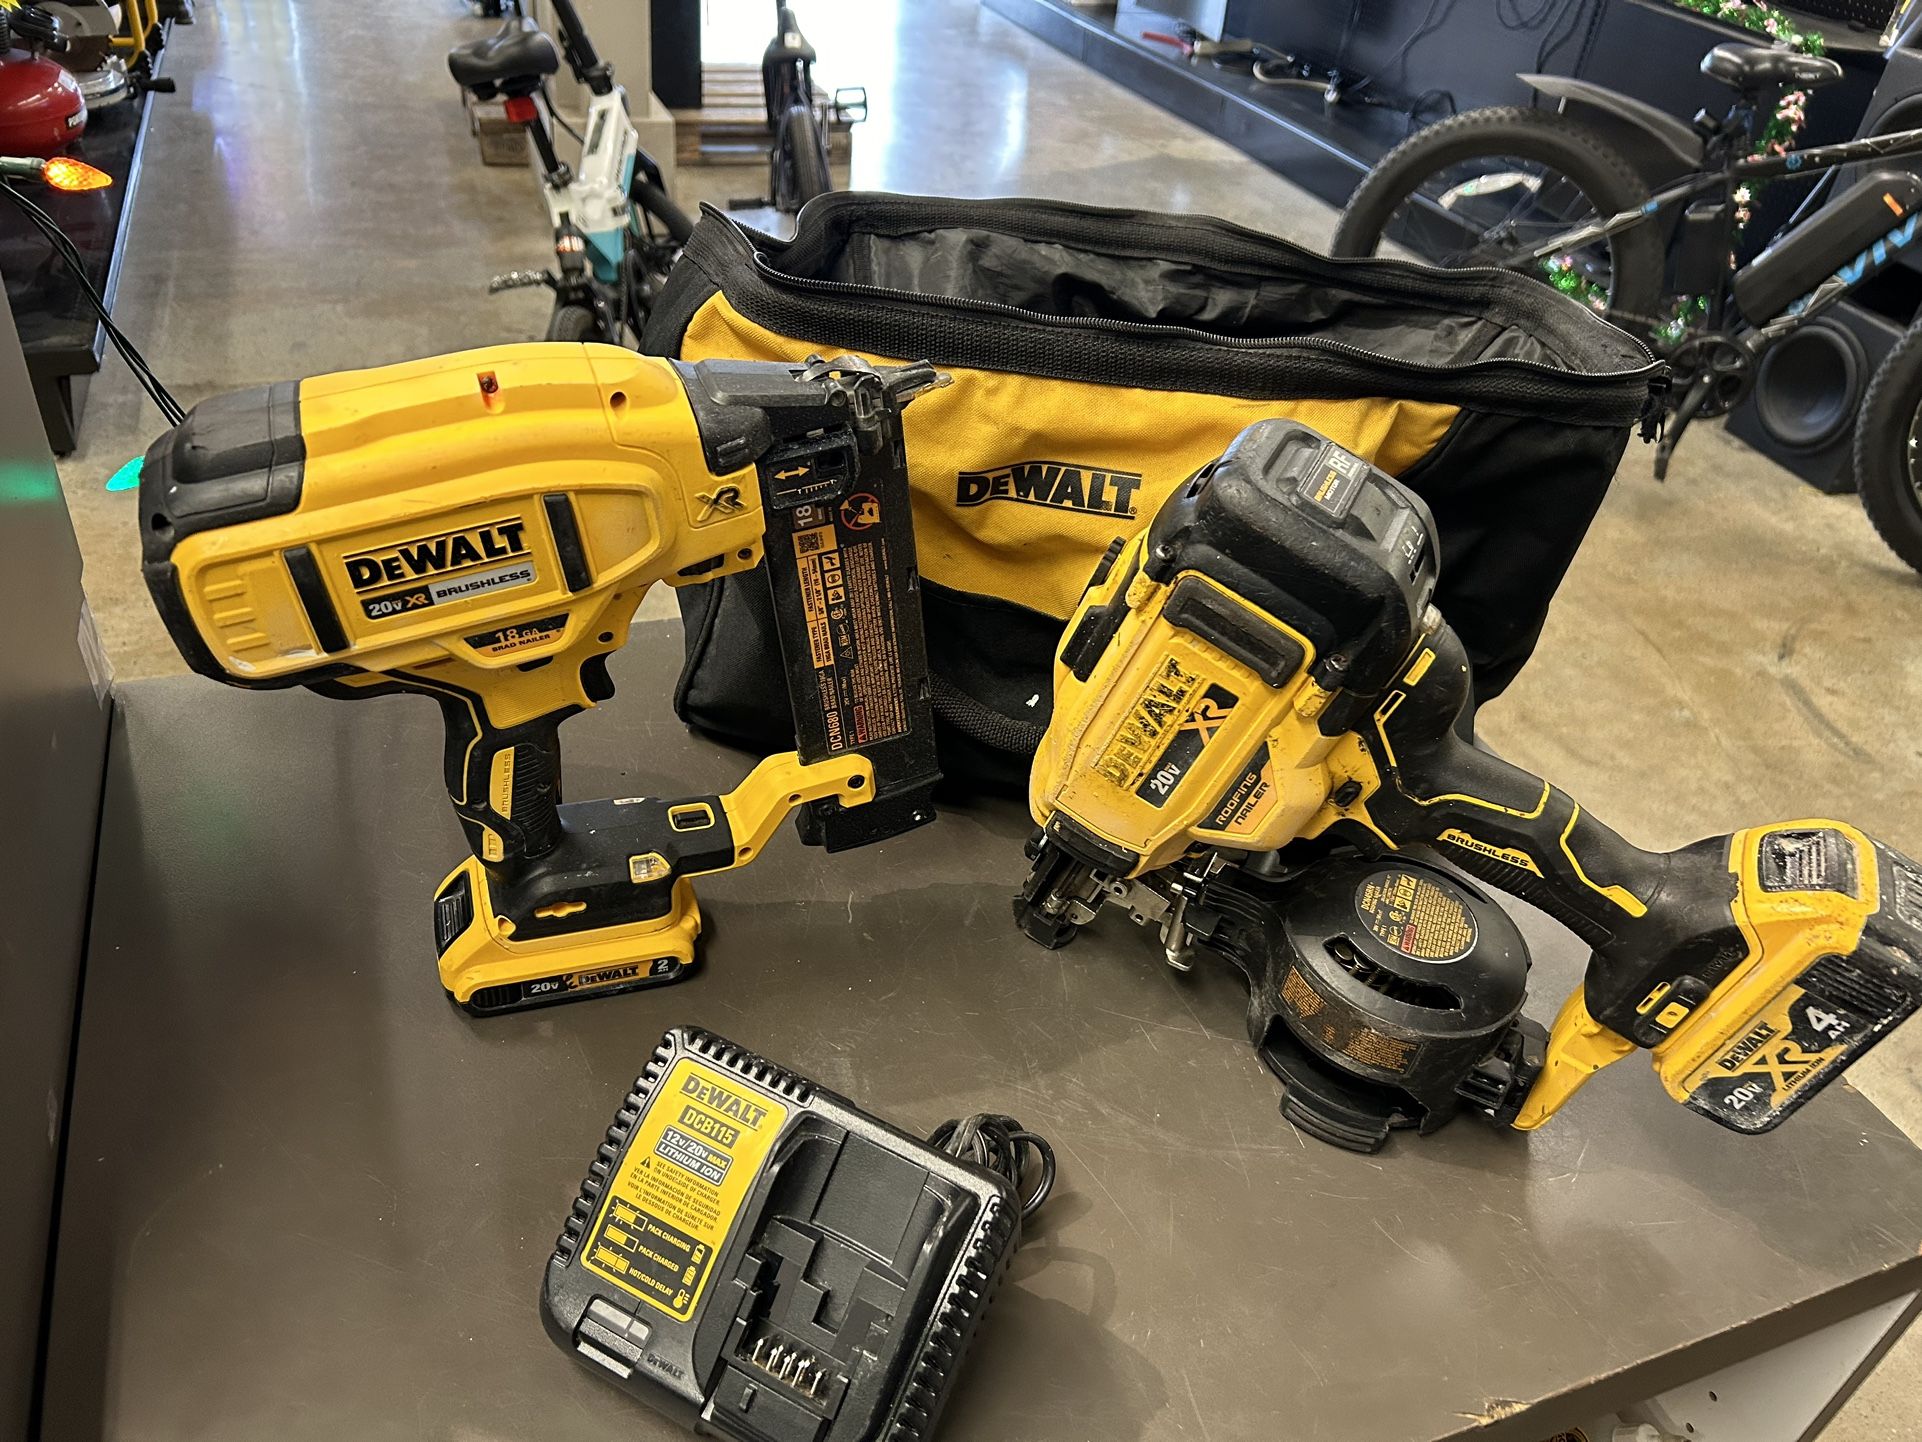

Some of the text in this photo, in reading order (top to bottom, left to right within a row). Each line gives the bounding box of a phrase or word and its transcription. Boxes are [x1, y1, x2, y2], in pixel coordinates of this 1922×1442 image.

[695, 485, 747, 522] XR
[957, 464, 1142, 514] DEWALT
[1323, 478, 1340, 500] MOTOR
[795, 504, 813, 526] 18
[344, 521, 528, 588] DEWALT
[405, 591, 429, 607] XR
[435, 569, 531, 598] BRUSHLESS
[492, 633, 551, 652] BRAD NAILER
[495, 628, 540, 643] 18 GA
[820, 683, 830, 710] BRUSHLESS
[825, 710, 843, 750] DCN680
[853, 705, 866, 734] WARNING
[1095, 656, 1198, 789] DEWALT
[1176, 694, 1233, 746] XR
[501, 753, 510, 811] BRUSHLESS
[1215, 771, 1257, 825] ROOFING
[1233, 781, 1270, 826] NAILER
[1446, 832, 1529, 867] BRUSHLESS
[578, 964, 639, 985] DEWALT
[656, 959, 669, 969] 2
[1805, 1006, 1838, 1032] 4
[1827, 1021, 1851, 1040] AH
[1717, 1021, 1779, 1071] DEWALT
[1781, 1056, 1824, 1091] LITHIUM ION
[680, 1074, 767, 1127] DEWALT
[682, 1108, 735, 1144] DCB115
[652, 1166, 661, 1174] ON
[658, 1142, 721, 1180] LITHIUM ION
[706, 1153, 727, 1169] MAX
[629, 1172, 637, 1180] EN
[644, 1180, 660, 1191] PARTE
[659, 1188, 682, 1203] INFERIOR
[633, 1166, 643, 1175] VER
[684, 1193, 692, 1201] DE
[692, 1197, 721, 1216] SEGURIDAD
[656, 1161, 719, 1197] SEE SAFETY INFORMATION
[626, 1181, 639, 1191] VOIR
[638, 1187, 677, 1210] L'INFORMATION
[703, 1221, 714, 1230] SUR
[641, 1196, 664, 1212] DESSOUS
[646, 1224, 691, 1252] PACK CHARGING
[637, 1244, 680, 1272] PACK CHARGED
[627, 1267, 673, 1296] HOT/COLD DELAY
